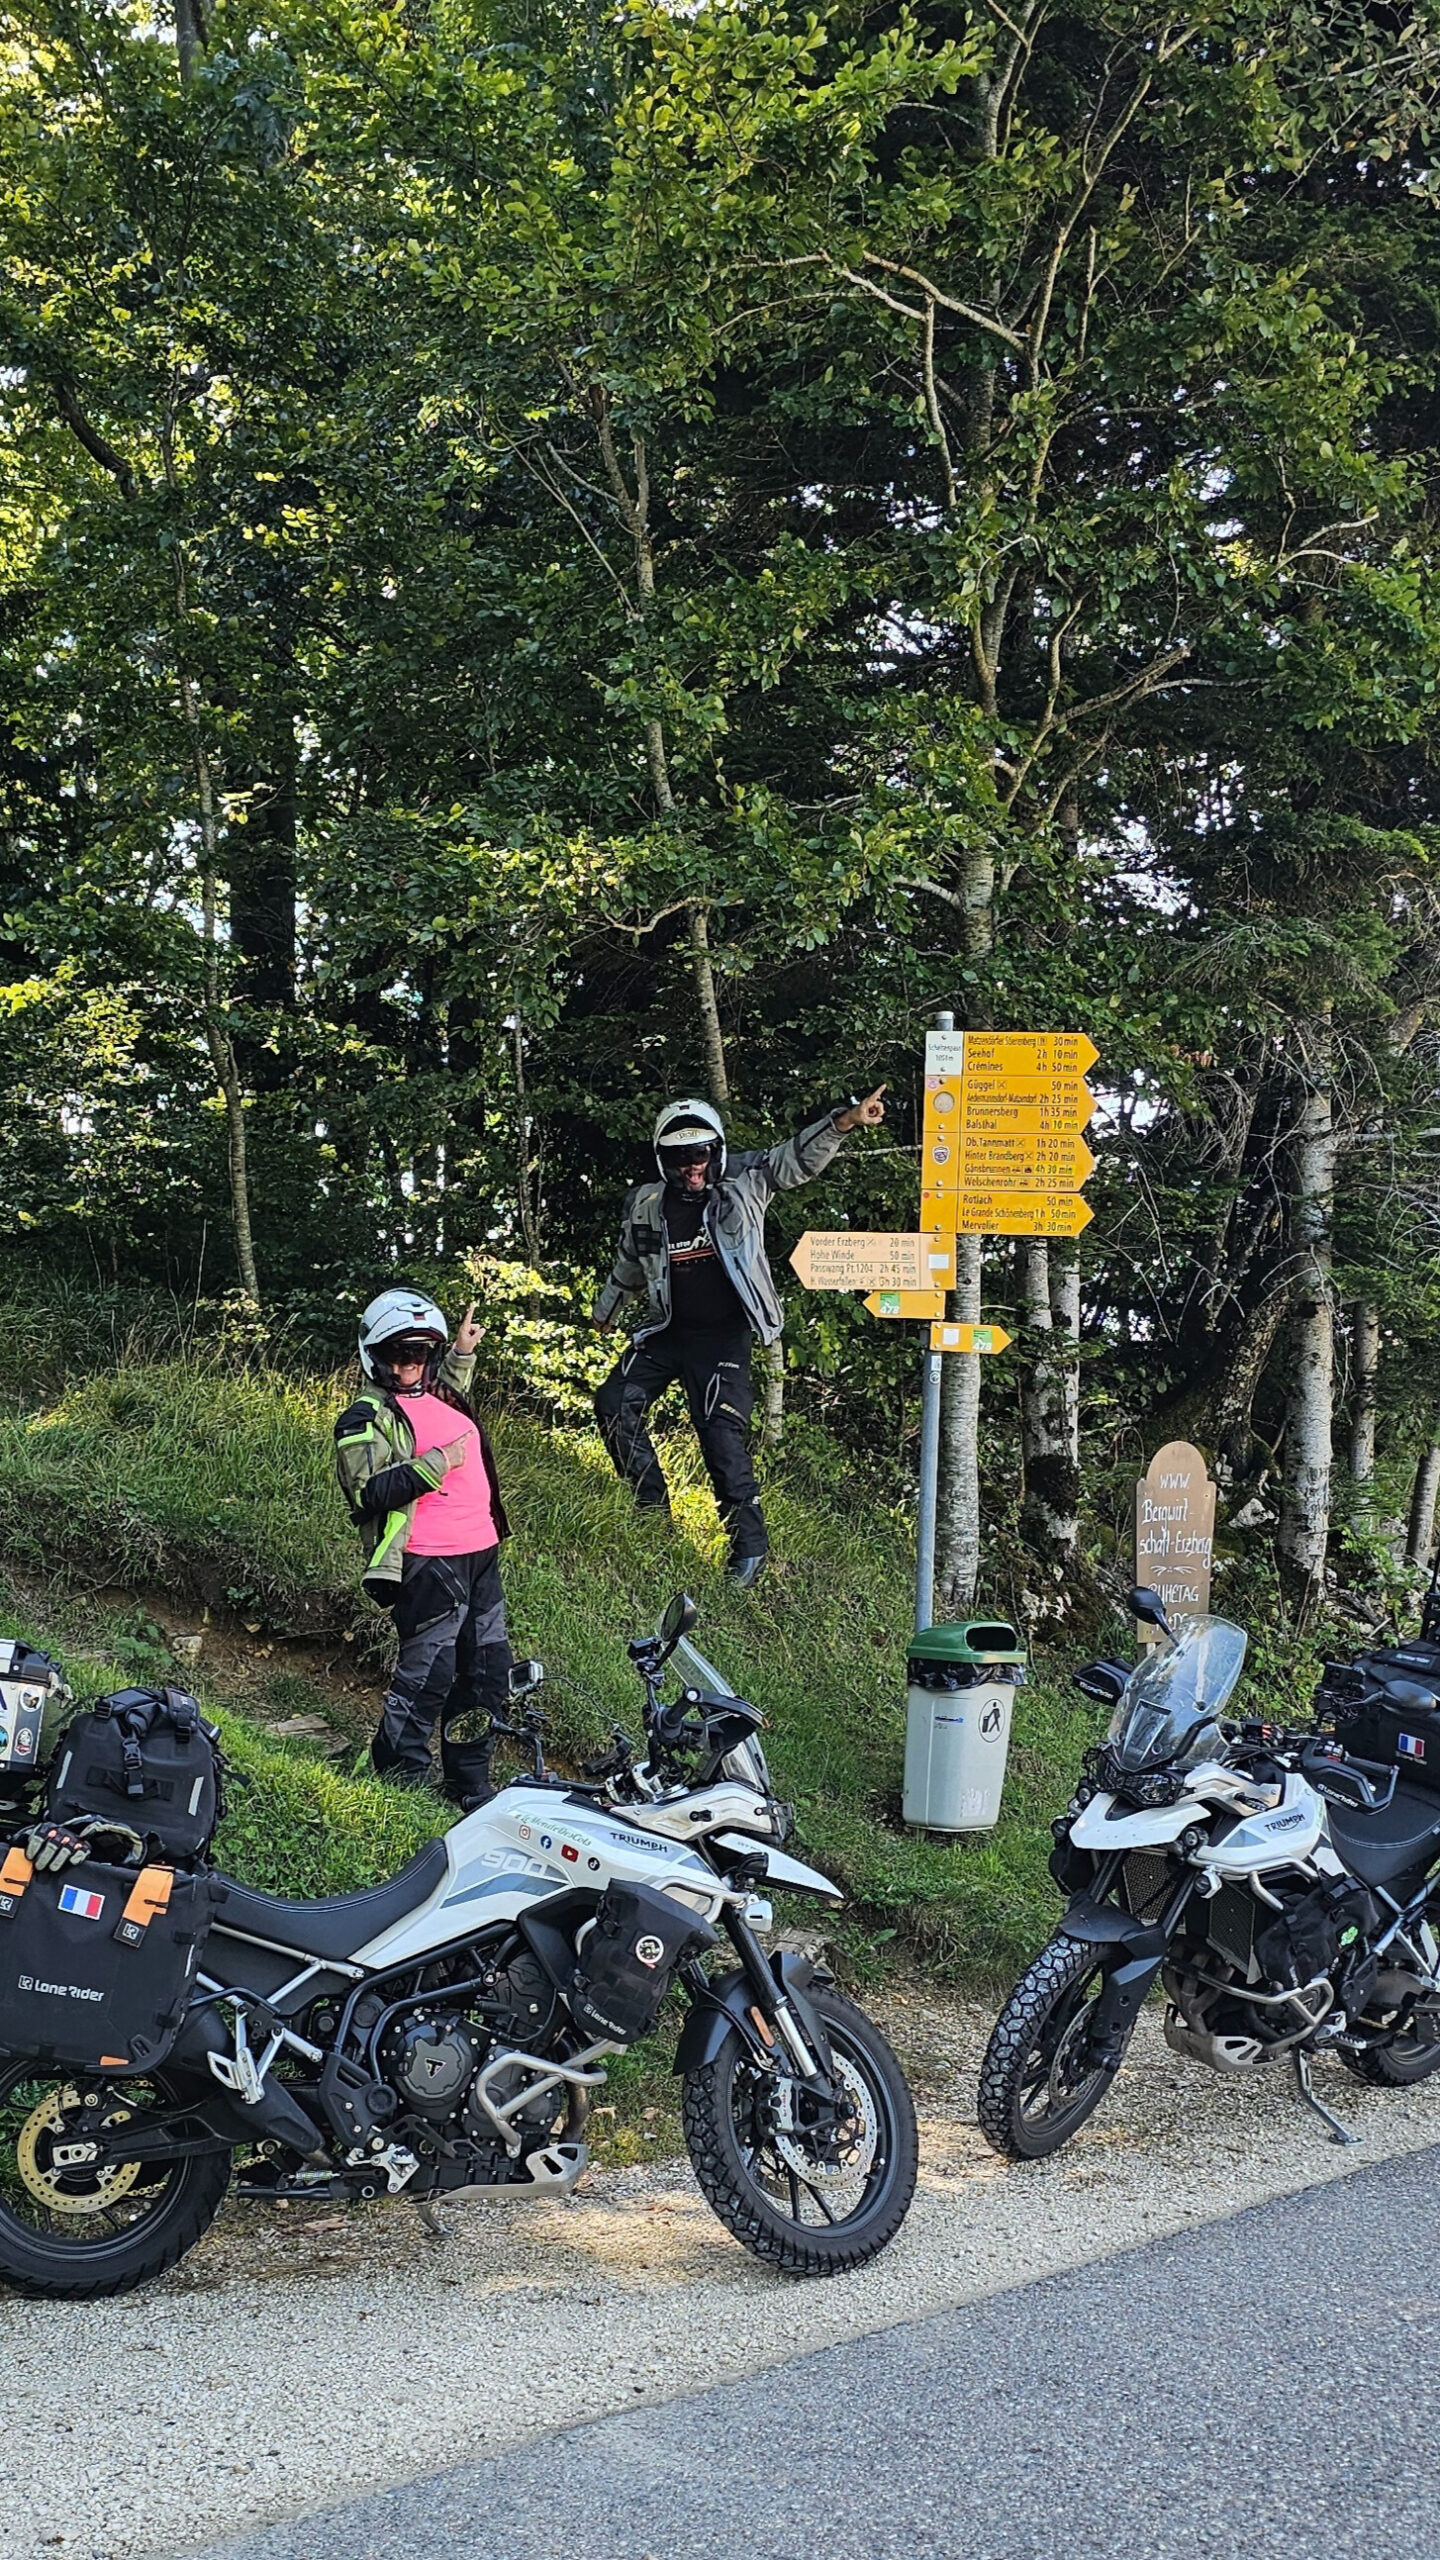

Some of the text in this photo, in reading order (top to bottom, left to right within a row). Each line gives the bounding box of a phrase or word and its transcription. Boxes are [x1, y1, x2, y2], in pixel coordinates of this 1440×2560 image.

[1053, 1036, 1063, 1046] 30
[1064, 1036, 1078, 1046] min
[968, 1048, 994, 1058] Seehof
[1053, 1049, 1063, 1059] 10
[1064, 1049, 1078, 1059] min
[967, 1061, 1003, 1072] Crémines
[1052, 1063, 1062, 1072] 50
[1063, 1063, 1077, 1072] min
[967, 1080, 1078, 1092] Güggel 50 min
[1052, 1094, 1061, 1104] 25
[1064, 1095, 1078, 1104] min
[966, 1106, 1018, 1119] Brunnersberg
[1051, 1107, 1060, 1117] 35
[1062, 1108, 1077, 1117] min
[966, 1119, 997, 1129] Balsthal
[1053, 1120, 1062, 1130] 10
[1064, 1121, 1078, 1130] min
[1048, 1139, 1058, 1148] 20
[1060, 1139, 1075, 1148] min
[965, 1150, 987, 1160] Hinter
[1049, 1152, 1059, 1161] 20
[1061, 1152, 1075, 1161] min
[1048, 1165, 1057, 1174] 30
[1059, 1165, 1073, 1174] min
[965, 1177, 1017, 1188] Welschenrohr
[1047, 1178, 1057, 1188] 25
[1060, 1178, 1074, 1188] min
[963, 1194, 1073, 1206] Rotlach 50 min
[1051, 1209, 1060, 1219] 50
[1061, 1209, 1076, 1219] min
[1046, 1222, 1056, 1232] 30
[1057, 1222, 1072, 1232] min
[837, 1237, 865, 1249] Erzberg
[901, 1238, 915, 1247] min
[890, 1251, 899, 1260] 50
[901, 1252, 915, 1260] min
[891, 1264, 900, 1274] 45
[902, 1265, 916, 1274] min
[902, 1277, 916, 1287] min
[1264, 1814, 1306, 1832] TRIUMPH
[609, 1832, 668, 1853] TRIUMPH
[481, 1851, 547, 1877] 900
[35, 1979, 68, 1996] Lone
